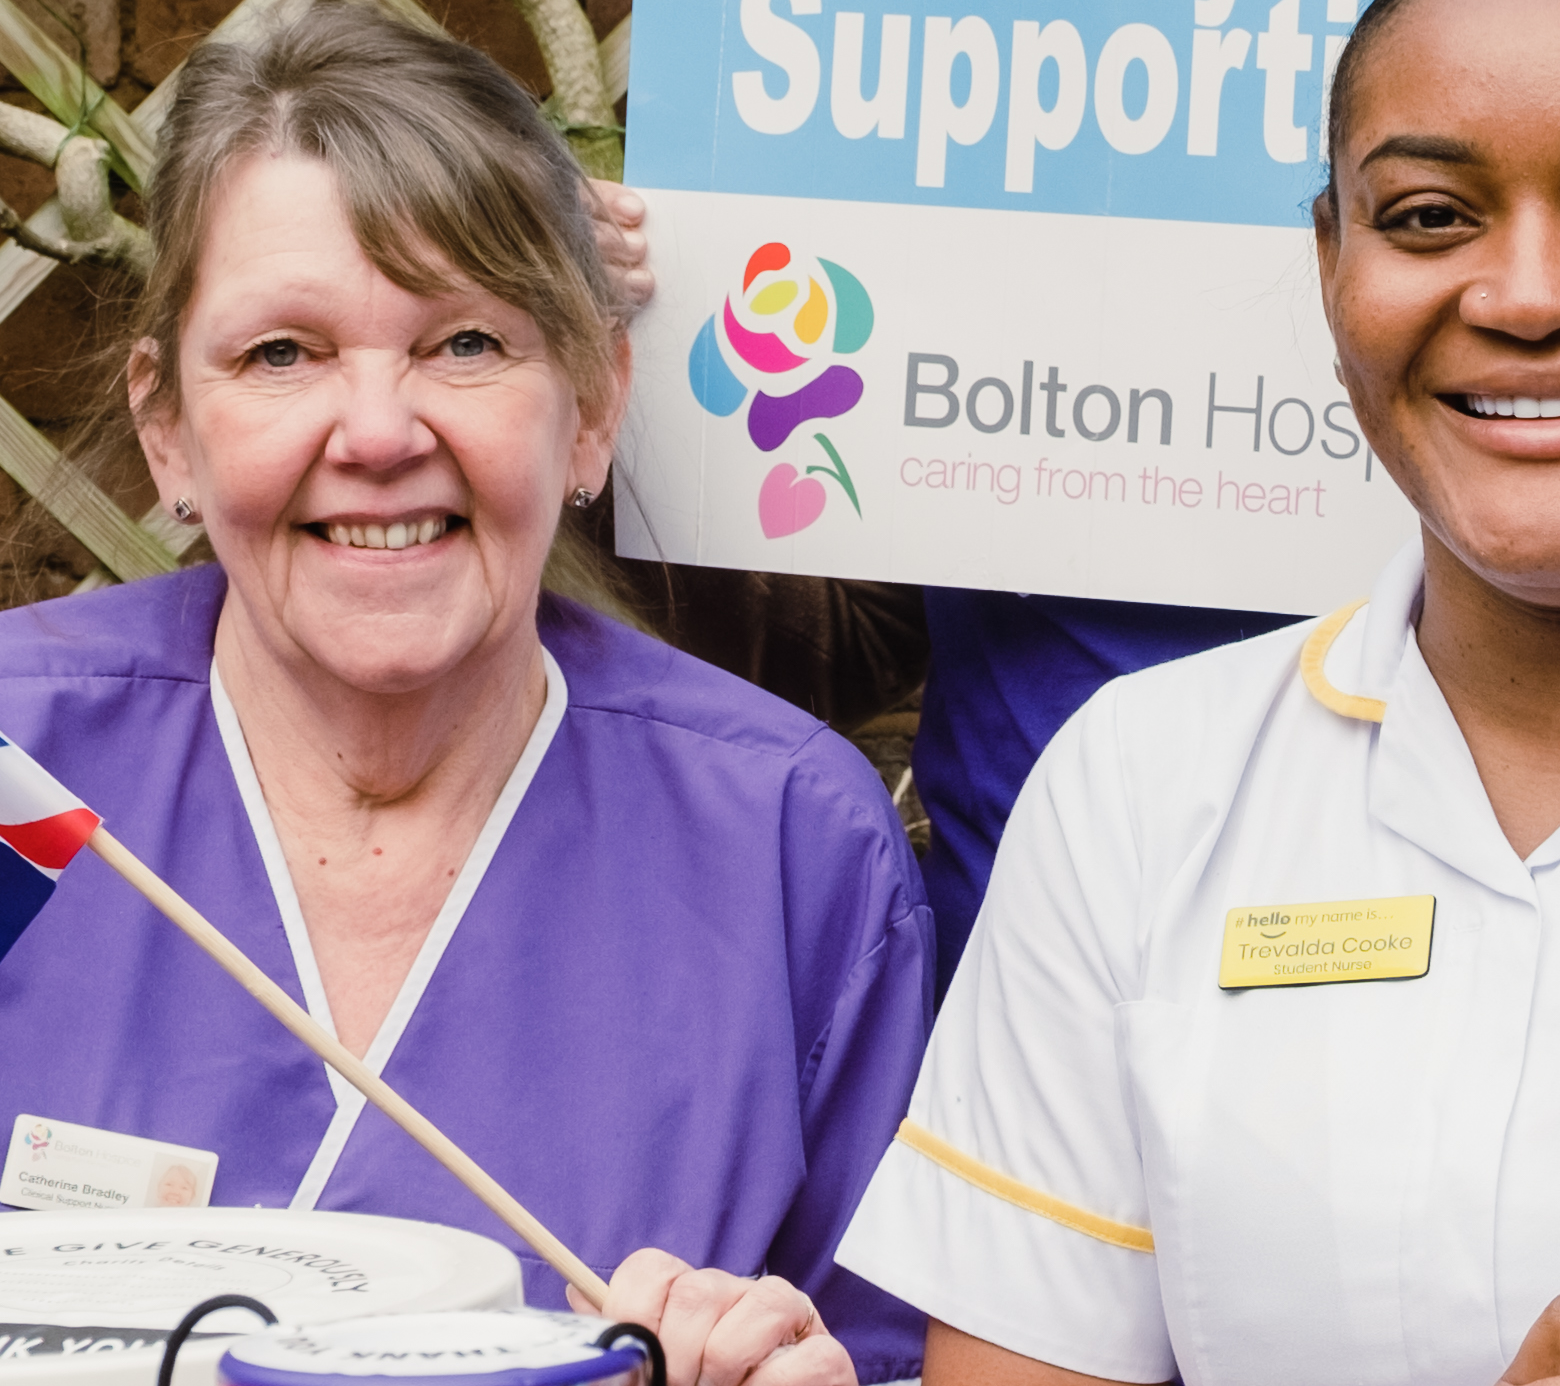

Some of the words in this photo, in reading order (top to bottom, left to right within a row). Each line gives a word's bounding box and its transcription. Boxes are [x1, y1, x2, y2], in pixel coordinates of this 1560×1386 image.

[902, 351, 1174, 446] Bolton
[899, 452, 1022, 506] caring
[1032, 457, 1127, 503] from
[1137, 465, 1204, 508] the
[1217, 470, 1328, 518] heart
[1246, 911, 1292, 928] hello
[1294, 913, 1318, 927] my
[1321, 910, 1363, 924] name
[1238, 938, 1335, 960] Trevalda
[1342, 933, 1413, 954] Cooke
[1273, 961, 1329, 976] Student
[1331, 959, 1373, 973] Nurse
[18, 1170, 79, 1193] Catherine
[82, 1183, 130, 1206] Bradley
[53, 1239, 172, 1254] GIVE
[187, 1238, 370, 1295] GENEROUSLY
